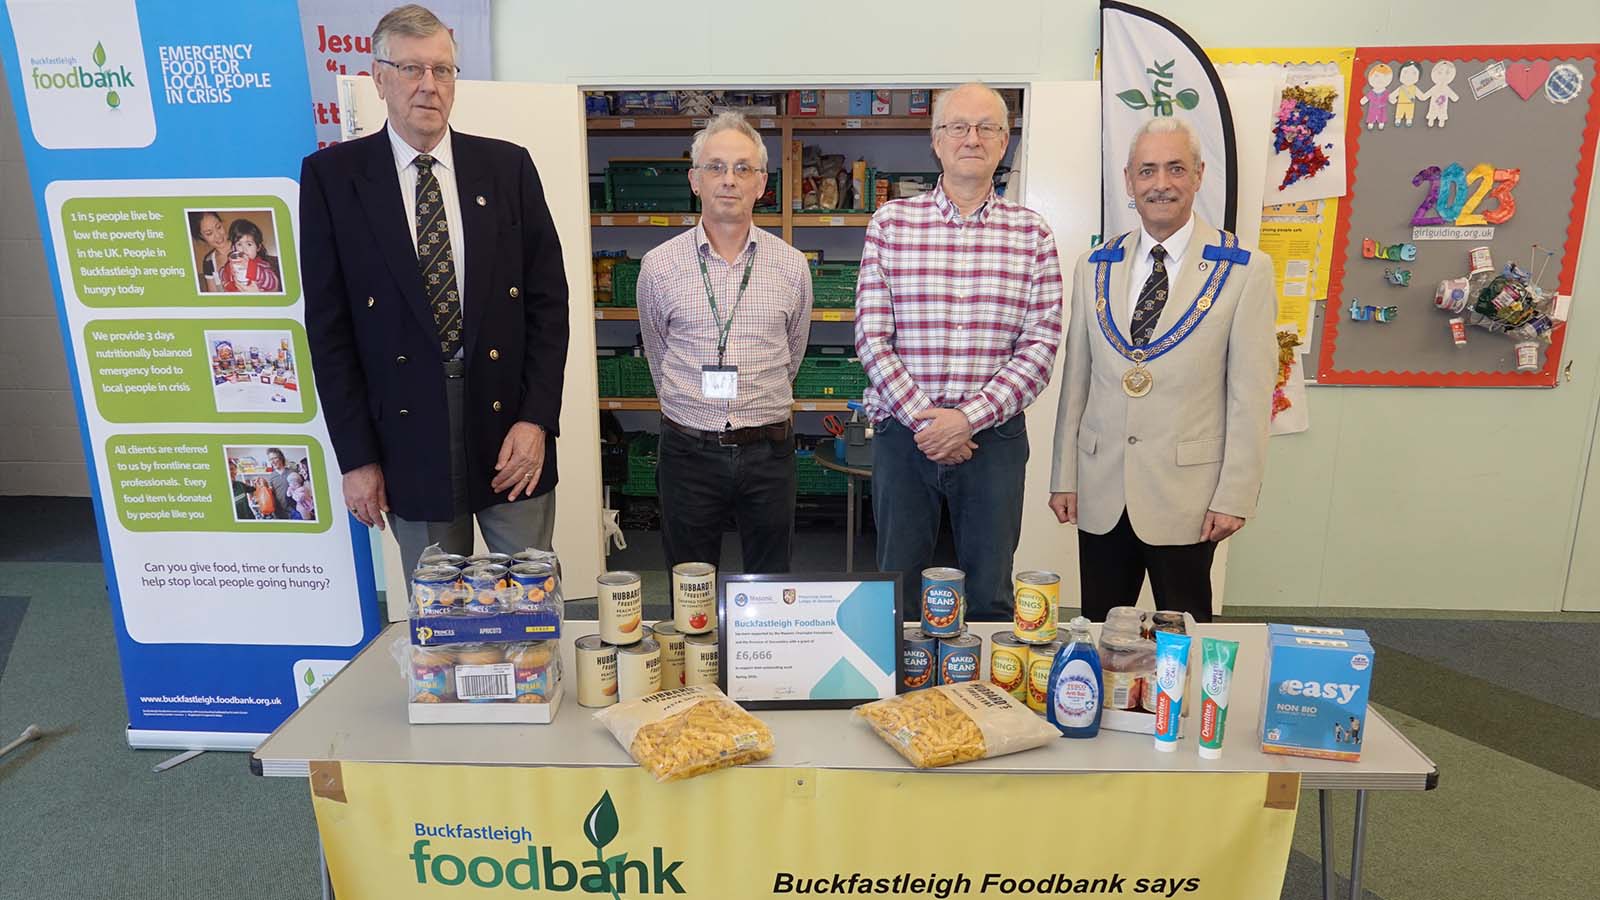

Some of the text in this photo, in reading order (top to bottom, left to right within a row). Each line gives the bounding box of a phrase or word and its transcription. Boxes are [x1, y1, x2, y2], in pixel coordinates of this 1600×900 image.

[159, 44, 253, 60] EMERGENCY
[162, 59, 240, 75] FOOD FOR
[32, 65, 135, 90] foodbank
[164, 73, 271, 89] LOCAL PEOPLE
[167, 88, 232, 104] IN CRISIS
[1410, 162, 1521, 226] 2023
[72, 211, 165, 223] 1 in 5 people live be-
[73, 230, 164, 242] low the poverty line
[1414, 227, 1493, 240] girlguiding.org.uk
[77, 247, 166, 259] in the UK. People in
[80, 267, 141, 278] Buckfastleigh
[160, 266, 185, 277] going
[84, 284, 145, 296] hungry today
[92, 330, 175, 343] We provide 3 days
[96, 347, 192, 359] nutritionally balanced
[99, 365, 183, 377] emergency food to
[102, 383, 190, 394] local people in crisis
[114, 445, 127, 455] All
[129, 445, 156, 454] clients
[174, 445, 208, 454] referred
[117, 462, 125, 471] to
[140, 462, 151, 473] by
[153, 461, 189, 471] frontline
[120, 477, 207, 489] professionals. Every
[123, 493, 212, 503] food item is donated
[127, 510, 204, 521] by people like you
[144, 562, 323, 576] Can you give food, time or funds to
[142, 577, 330, 591] help stop local people going hungry?
[930, 590, 952, 598] BAKED
[927, 597, 955, 605] BEANS
[424, 607, 450, 615] PRINCES
[735, 619, 836, 629] Buckfastleigh Foodbank
[736, 651, 772, 661] £6,666
[948, 663, 975, 671] BEANS
[1286, 679, 1361, 704] easy
[140, 695, 282, 706] www.buckfastleigh.foodbank.org.uk
[1276, 703, 1317, 713] NON BIO
[415, 822, 532, 844] Buckfastleigh
[409, 839, 687, 895] foodbank
[773, 872, 1201, 898] Buckfastleigh Foodbank says
